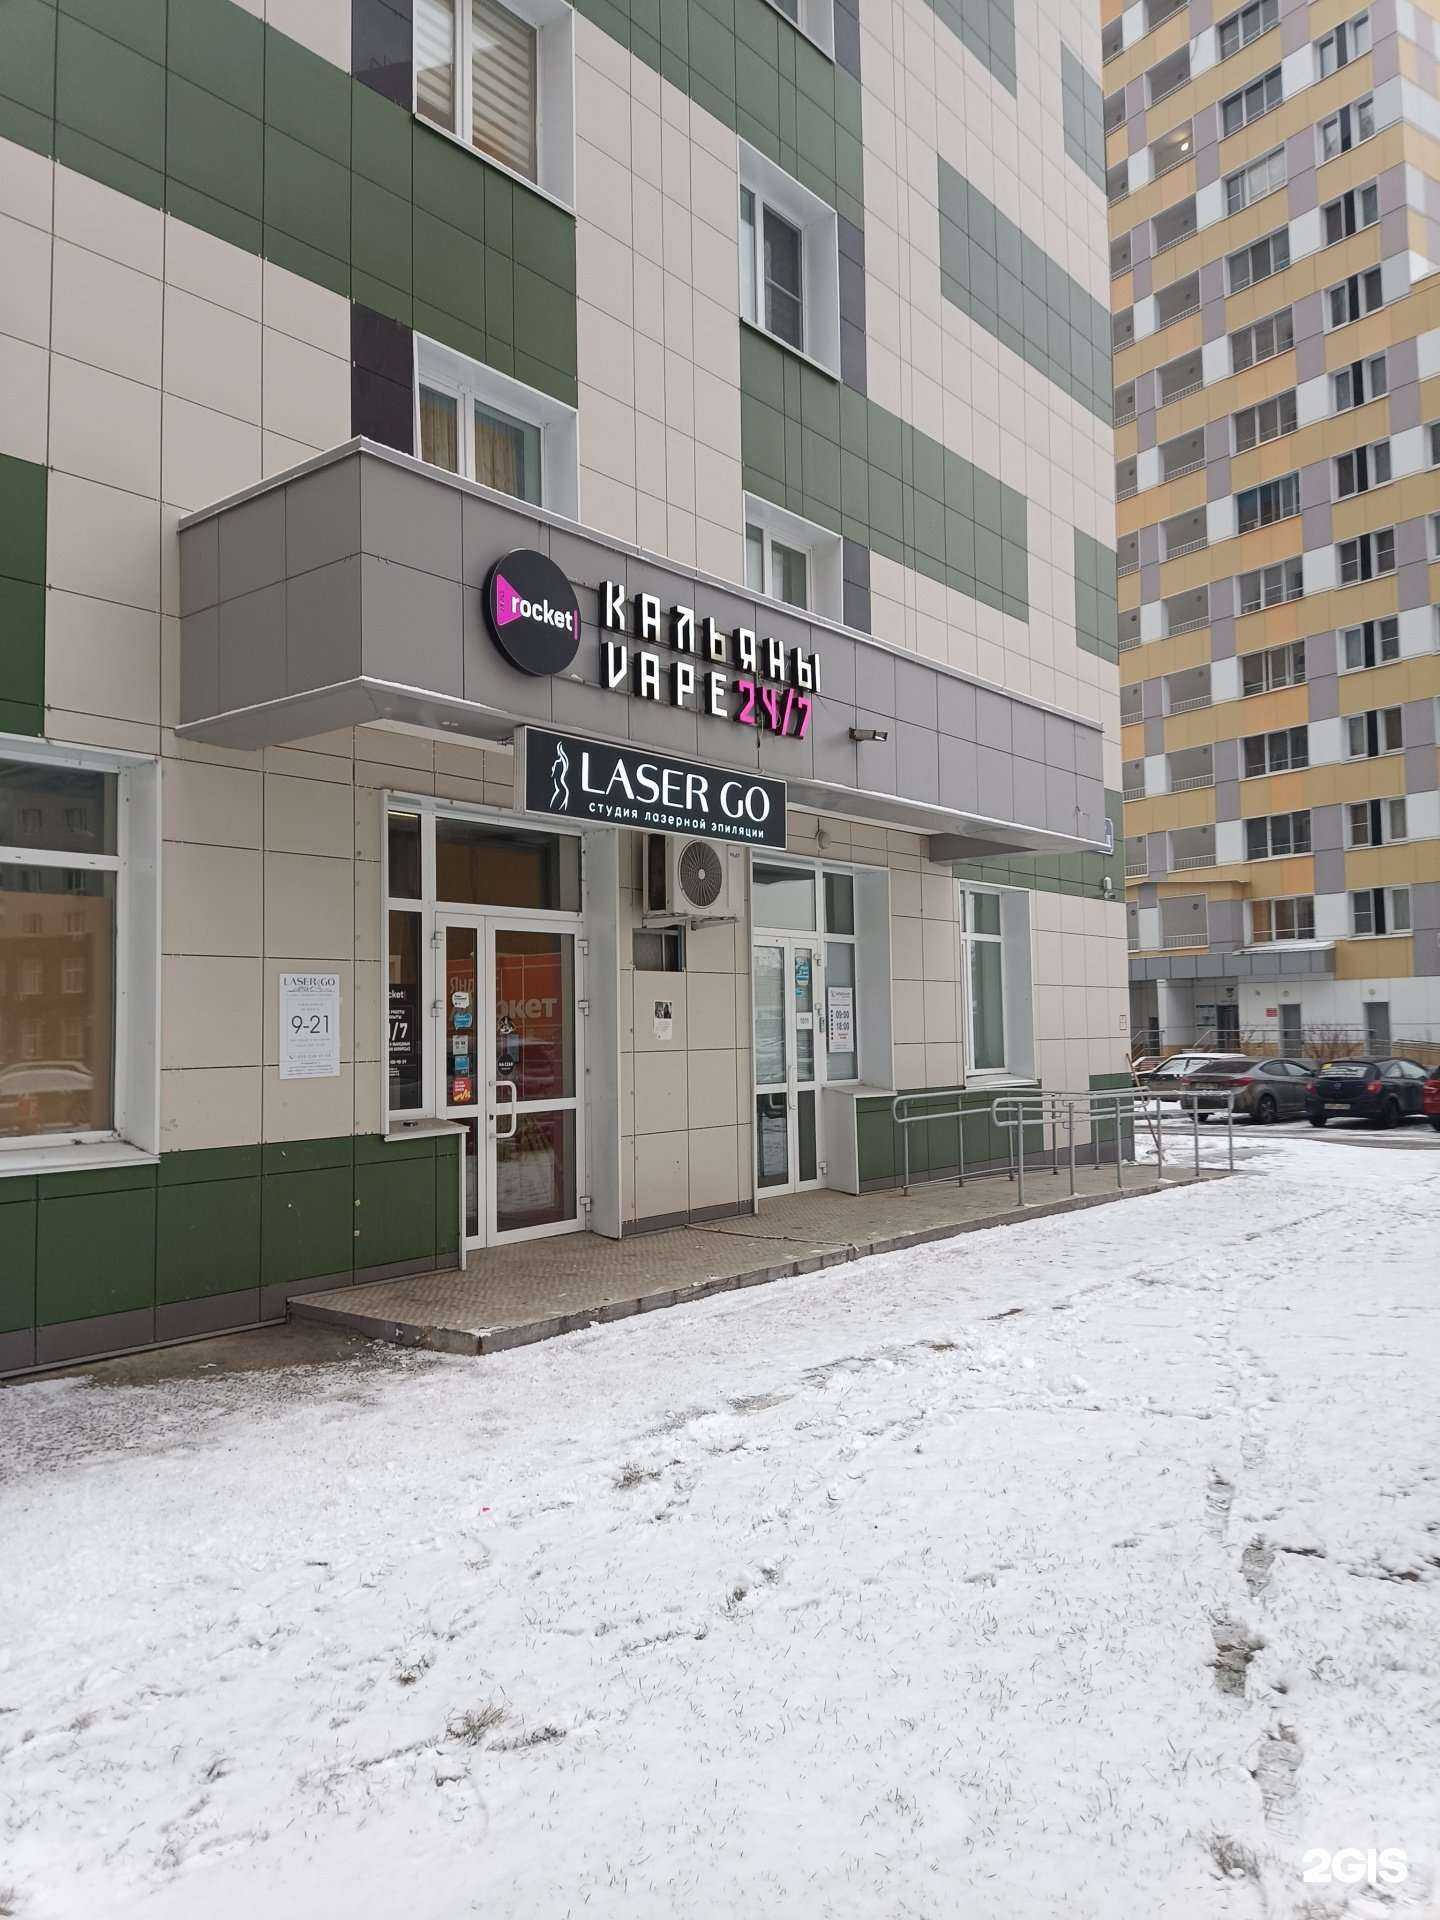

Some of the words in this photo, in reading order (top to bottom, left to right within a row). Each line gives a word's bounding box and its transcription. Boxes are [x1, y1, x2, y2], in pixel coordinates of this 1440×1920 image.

[511, 596, 573, 632] rocket
[601, 580, 821, 693] КАЛЬЯНЫ
[602, 641, 728, 718] VAPE
[736, 679, 813, 740] 24/7
[581, 751, 709, 813] LASER
[720, 781, 770, 822] GO
[588, 801, 638, 819] студия
[711, 822, 764, 839] эпиляции
[291, 1015, 330, 1034] 9-21
